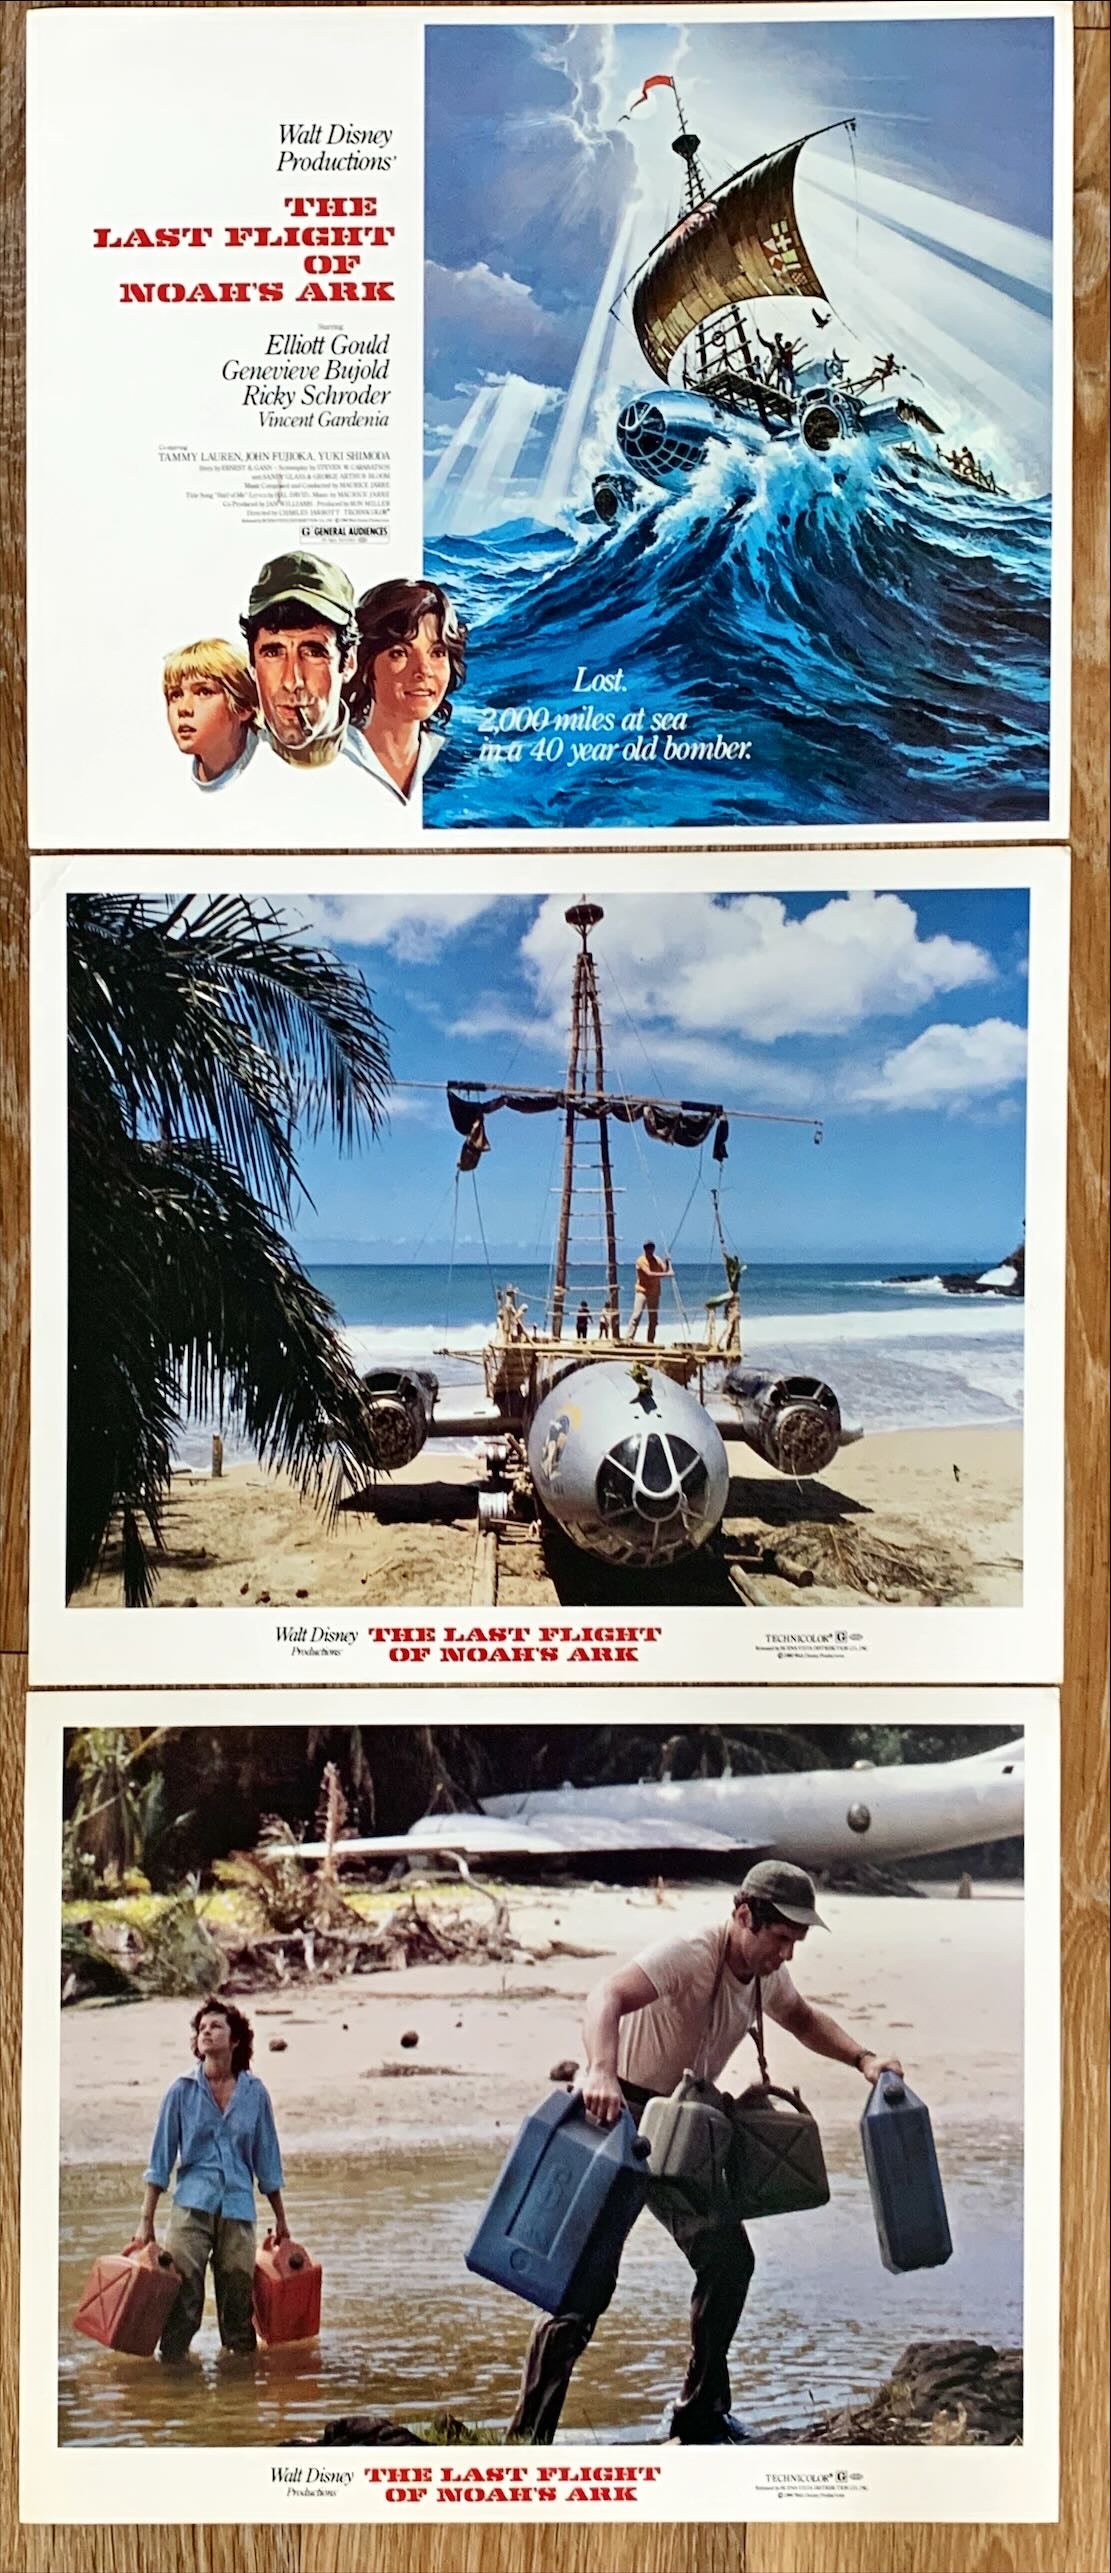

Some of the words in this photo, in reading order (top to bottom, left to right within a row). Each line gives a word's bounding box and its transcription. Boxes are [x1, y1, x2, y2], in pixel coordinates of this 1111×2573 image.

[280, 124, 322, 144] Walt
[325, 123, 392, 149] Disney
[284, 197, 377, 217] THE
[93, 228, 212, 248] LAST
[225, 227, 395, 247] FLIGHT
[304, 255, 360, 275] OF
[120, 282, 284, 303] NOAH'S
[295, 282, 395, 302] ARK
[265, 334, 325, 355] Elliott
[331, 333, 390, 355] Gould
[222, 359, 320, 380] Genevieve
[324, 359, 390, 384] Bujold
[242, 384, 296, 410] Ricky
[301, 382, 391, 405] Schroder
[259, 410, 314, 427] Vincent
[318, 411, 389, 427] Gardenia
[159, 452, 198, 462] TAMMY
[200, 452, 243, 463] LAUREN,
[244, 452, 270, 462] JOHN
[318, 451, 344, 461] YUKI
[346, 451, 391, 461] SHIMODA
[301, 527, 311, 536] G
[314, 527, 347, 536] GENERAL
[348, 526, 388, 536] AUDIENCES
[572, 666, 627, 693] Lost.
[478, 707, 550, 736] 2,000
[553, 705, 615, 732] miles
[620, 707, 646, 731] at
[650, 711, 688, 731] sea
[529, 737, 564, 762] 40
[566, 743, 620, 768] year
[621, 735, 657, 761] old
[663, 734, 753, 761] bomber.
[277, 1627, 308, 1642] Walt
[310, 1627, 358, 1646] Disney
[368, 1627, 435, 1642] THE
[444, 1627, 530, 1642] LAST
[539, 1627, 662, 1642] FLIGHT
[836, 1632, 846, 1642] G
[389, 1648, 431, 1662] OF
[440, 1647, 558, 1662] NOAH'S
[567, 1647, 639, 1662] ARK
[272, 2467, 302, 2483] Walt
[306, 2467, 354, 2486] Disney
[364, 2468, 432, 2483] THE
[440, 2467, 528, 2482] LAST
[537, 2467, 661, 2482] FLIGHT
[836, 2471, 846, 2482] G
[385, 2488, 427, 2502] OF
[437, 2487, 556, 2502] NOAH'S
[565, 2487, 637, 2501] ARK
